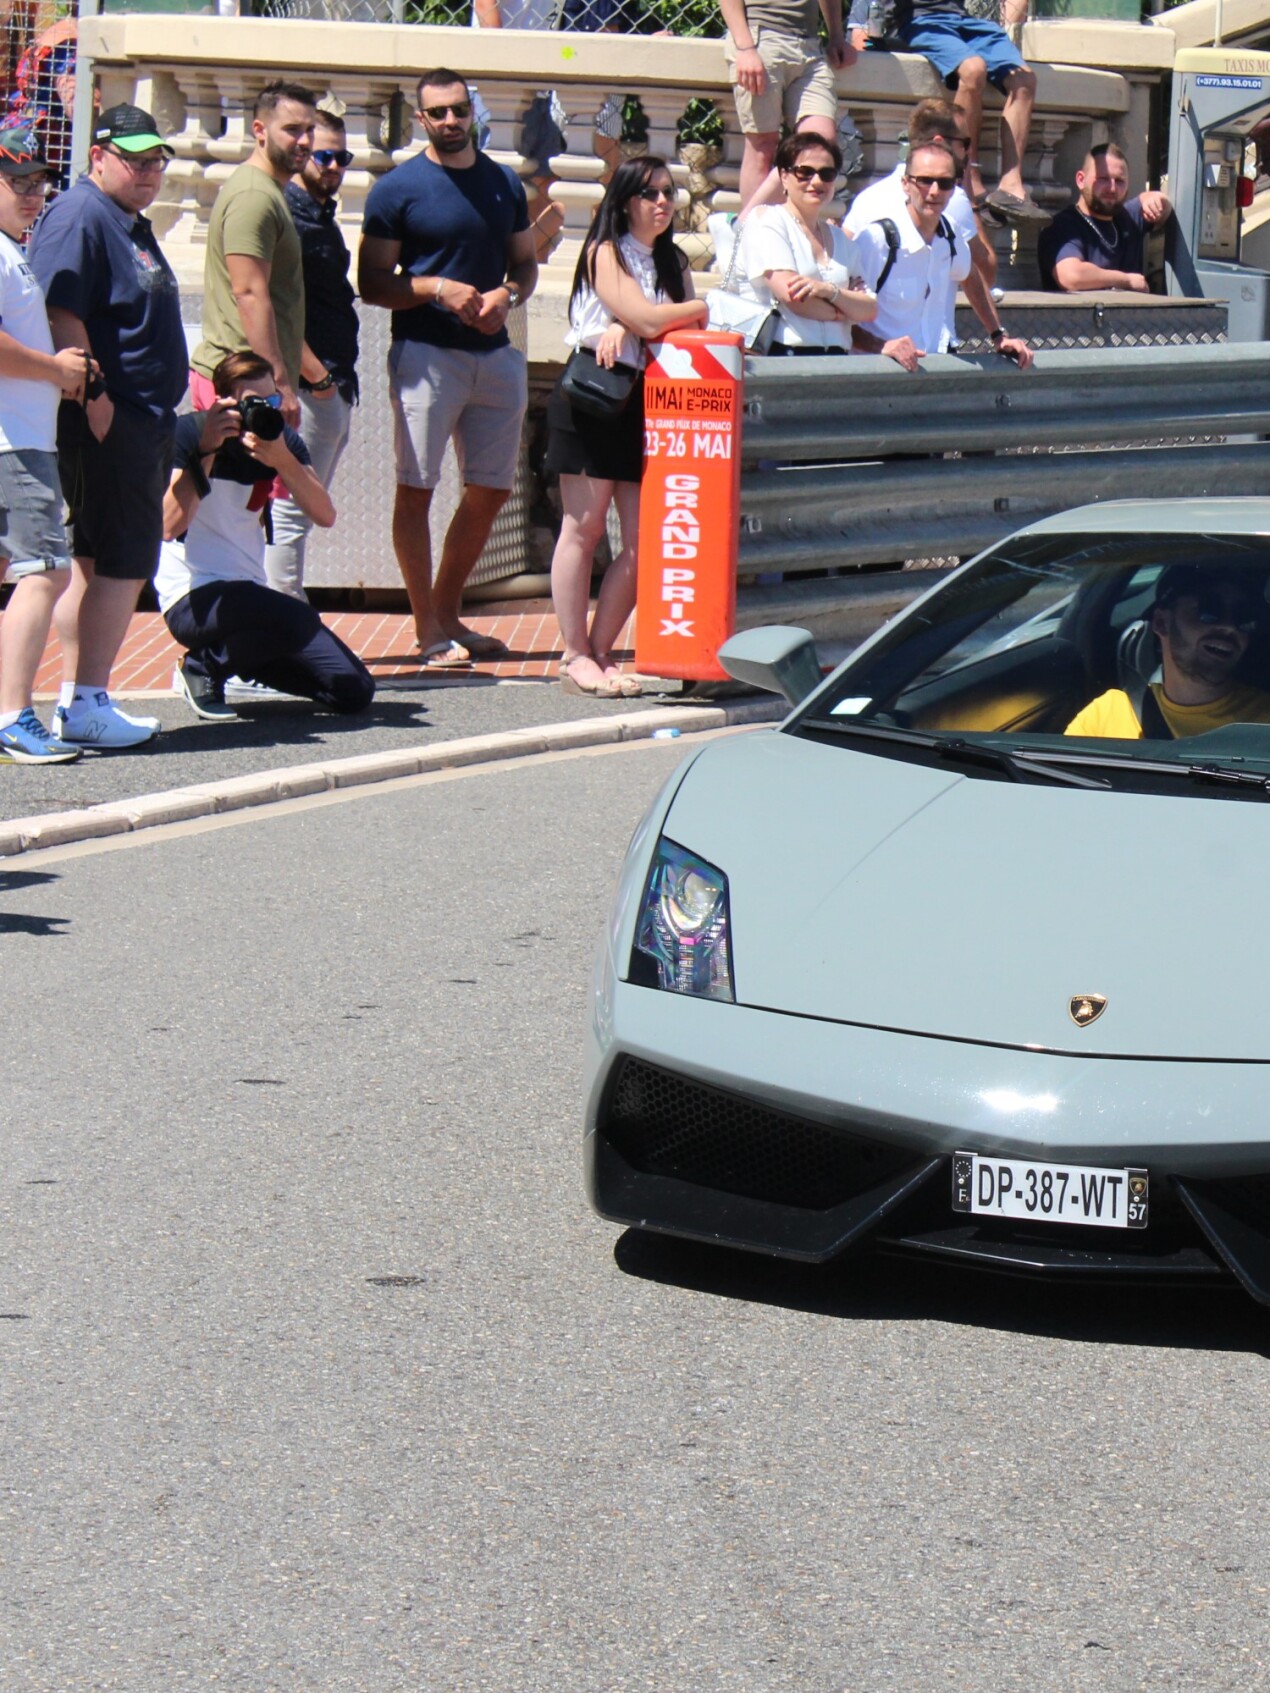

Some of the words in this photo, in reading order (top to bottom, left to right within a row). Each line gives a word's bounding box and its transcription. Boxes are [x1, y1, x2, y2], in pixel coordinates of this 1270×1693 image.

[1223, 58, 1255, 73] TAXIS
[687, 387, 732, 399] MONACO
[687, 399, 731, 413] E-PRIX
[691, 419, 701, 431] DE
[701, 420, 732, 432] MONACO
[644, 430, 687, 458] 23-26
[693, 432, 732, 459] MAI
[661, 474, 701, 560] GRAND
[658, 568, 696, 638] PRIX
[977, 1164, 1123, 1219] DP-387-WT
[1128, 1203, 1146, 1221] 57
